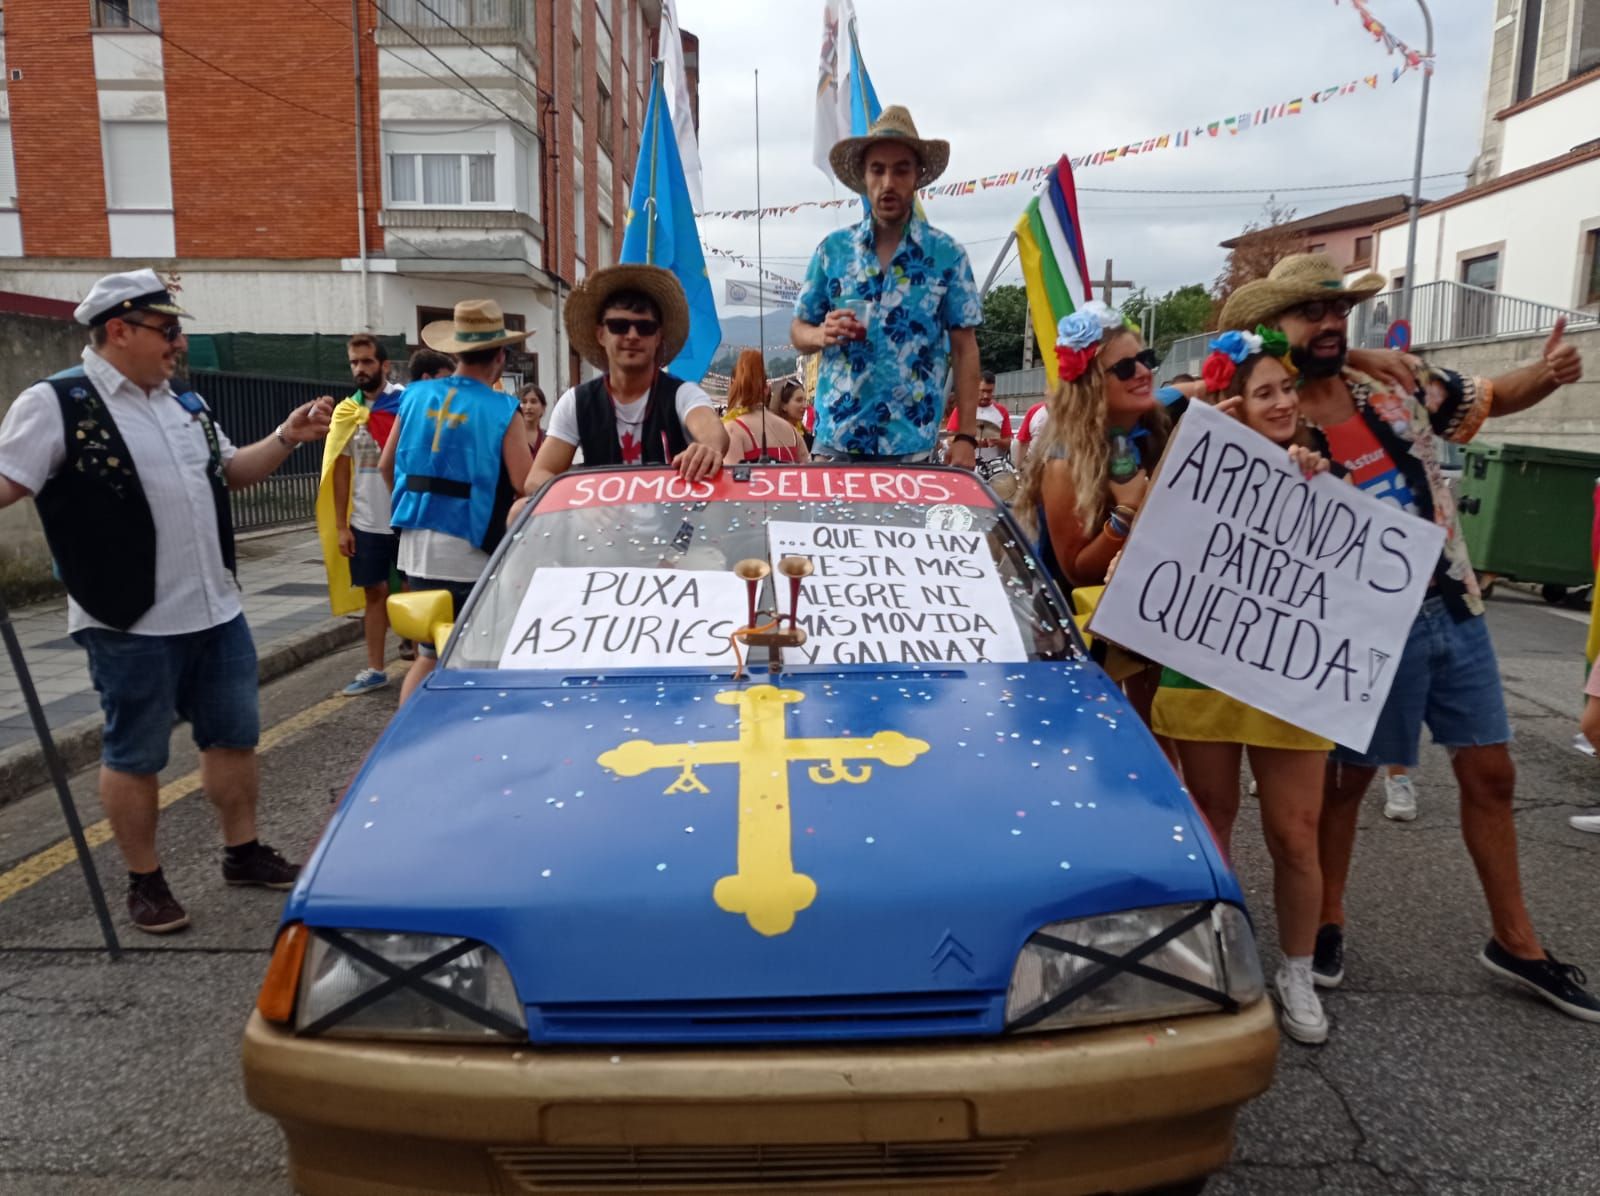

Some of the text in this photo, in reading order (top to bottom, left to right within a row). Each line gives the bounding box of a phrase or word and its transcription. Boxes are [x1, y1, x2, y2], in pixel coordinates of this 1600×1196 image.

[748, 471, 951, 501] SELLEROS
[1168, 431, 1412, 593] ARRIONDAS
[874, 530, 916, 549] NO
[925, 534, 980, 555] HAY
[914, 556, 985, 579] MÁS
[1200, 523, 1329, 619] PATRIA
[580, 571, 700, 608] PUXA
[921, 585, 971, 607] NI
[511, 615, 736, 656] ASTURIES
[861, 612, 998, 635] MOVIDA
